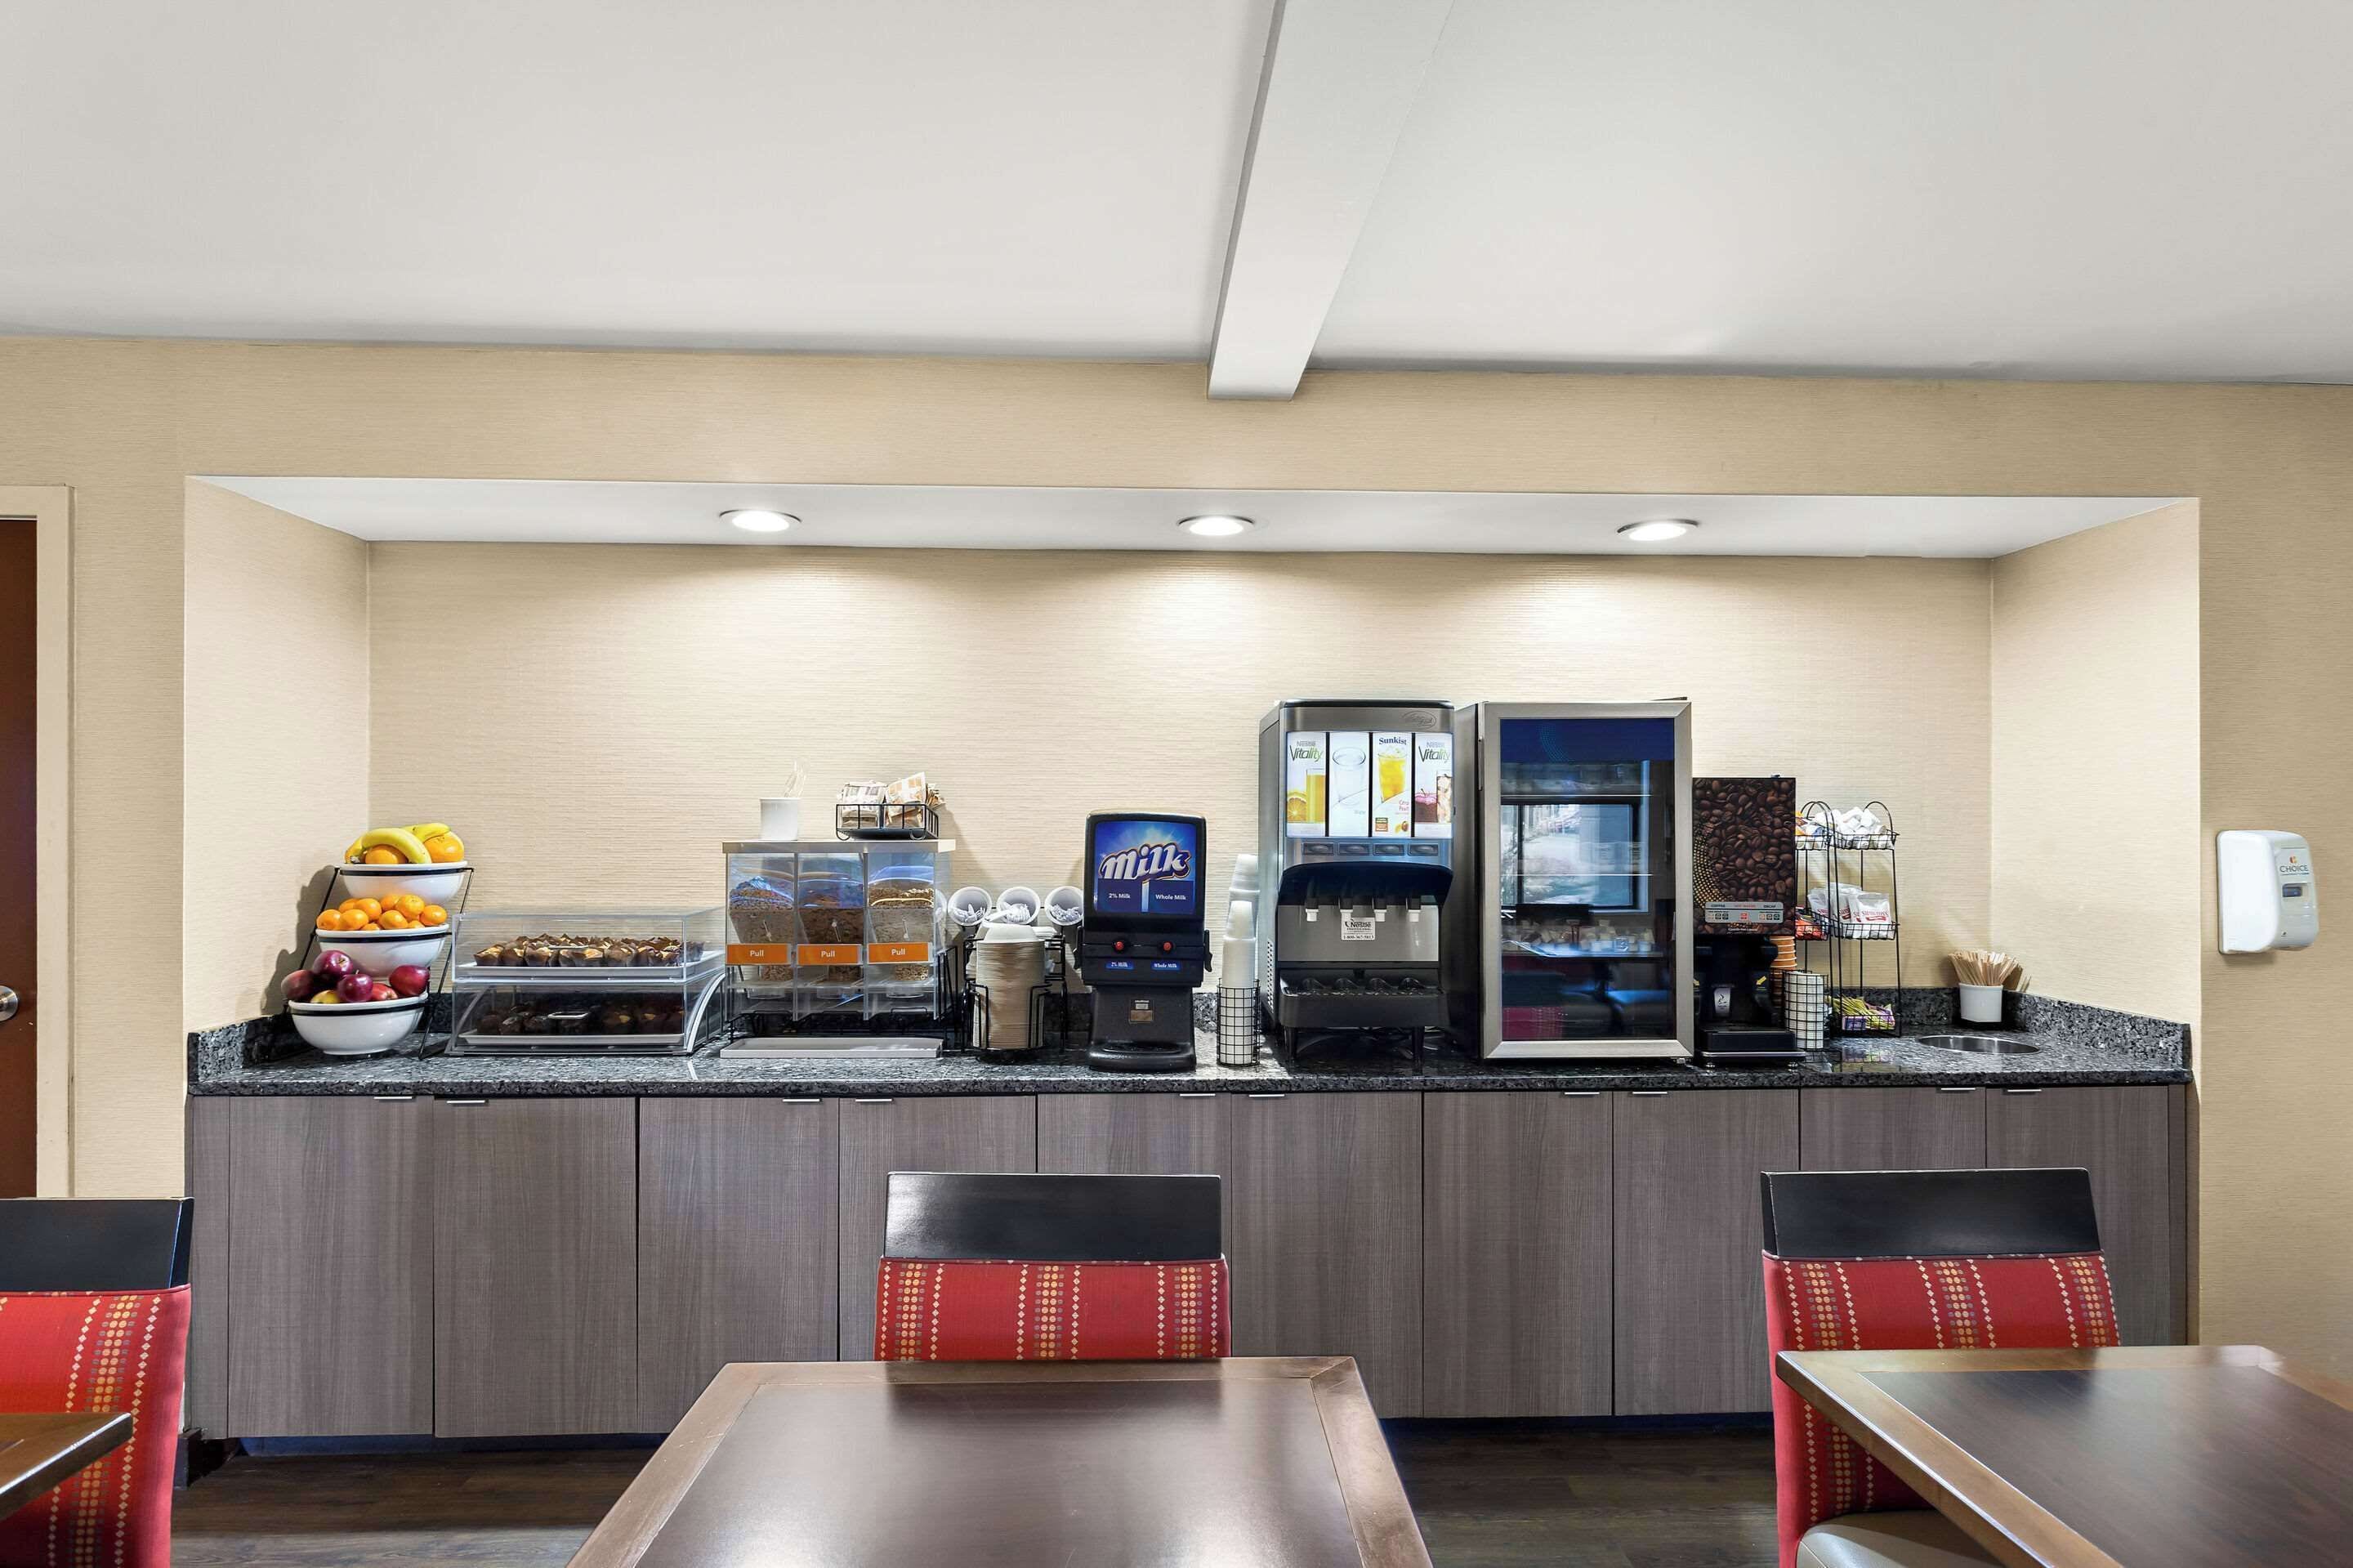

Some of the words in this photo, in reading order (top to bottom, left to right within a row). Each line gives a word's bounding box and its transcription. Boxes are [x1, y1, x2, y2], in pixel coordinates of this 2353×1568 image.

[1378, 736, 1407, 745] Sunkist
[1289, 745, 1323, 762] Vitality
[1418, 745, 1450, 763] Vitality
[2279, 864, 2309, 873] CHOICE
